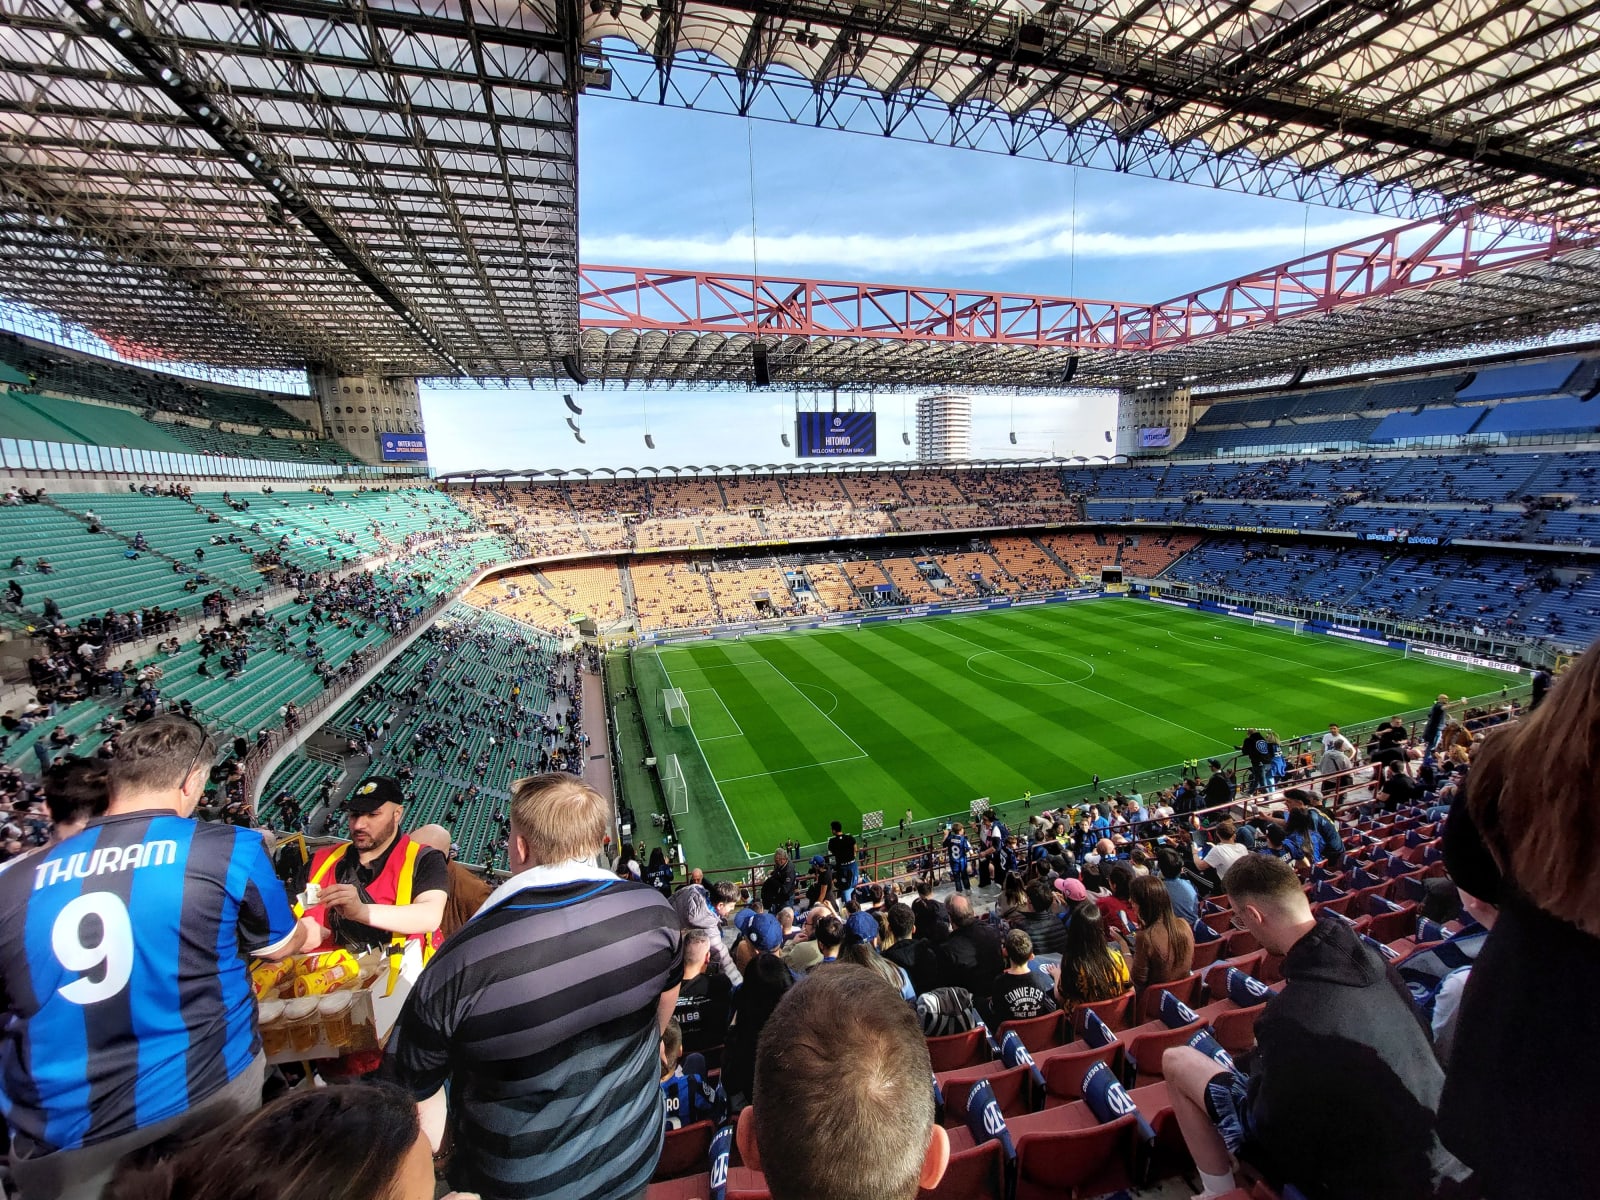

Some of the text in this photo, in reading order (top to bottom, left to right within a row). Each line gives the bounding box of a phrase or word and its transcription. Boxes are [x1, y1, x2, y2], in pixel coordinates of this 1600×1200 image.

[34, 838, 179, 891] THURAM
[51, 891, 134, 1005] 9
[1004, 986, 1044, 1004] CONVERSE
